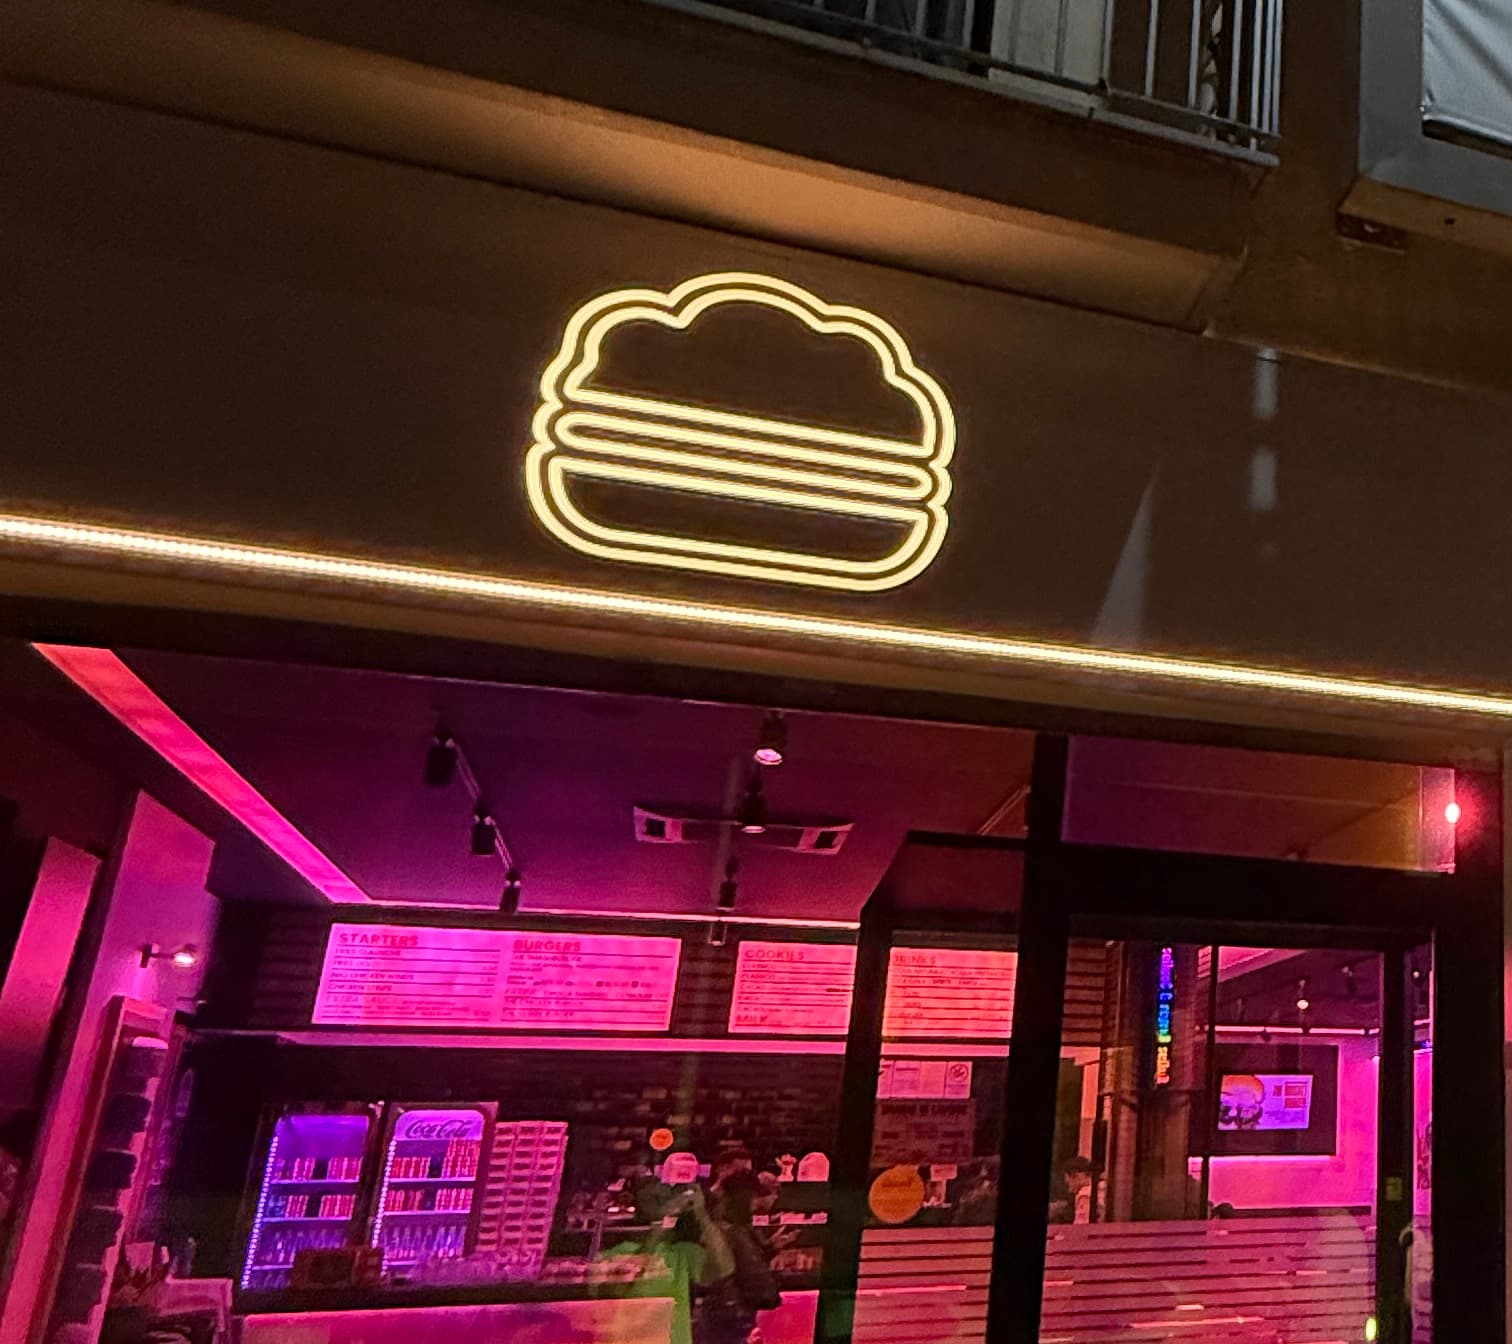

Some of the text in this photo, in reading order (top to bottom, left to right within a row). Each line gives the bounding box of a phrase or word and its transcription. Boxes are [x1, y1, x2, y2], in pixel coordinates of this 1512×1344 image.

[339, 933, 419, 946] STARTERS
[514, 939, 582, 953] BURGERS
[745, 950, 804, 961] COOKIES
